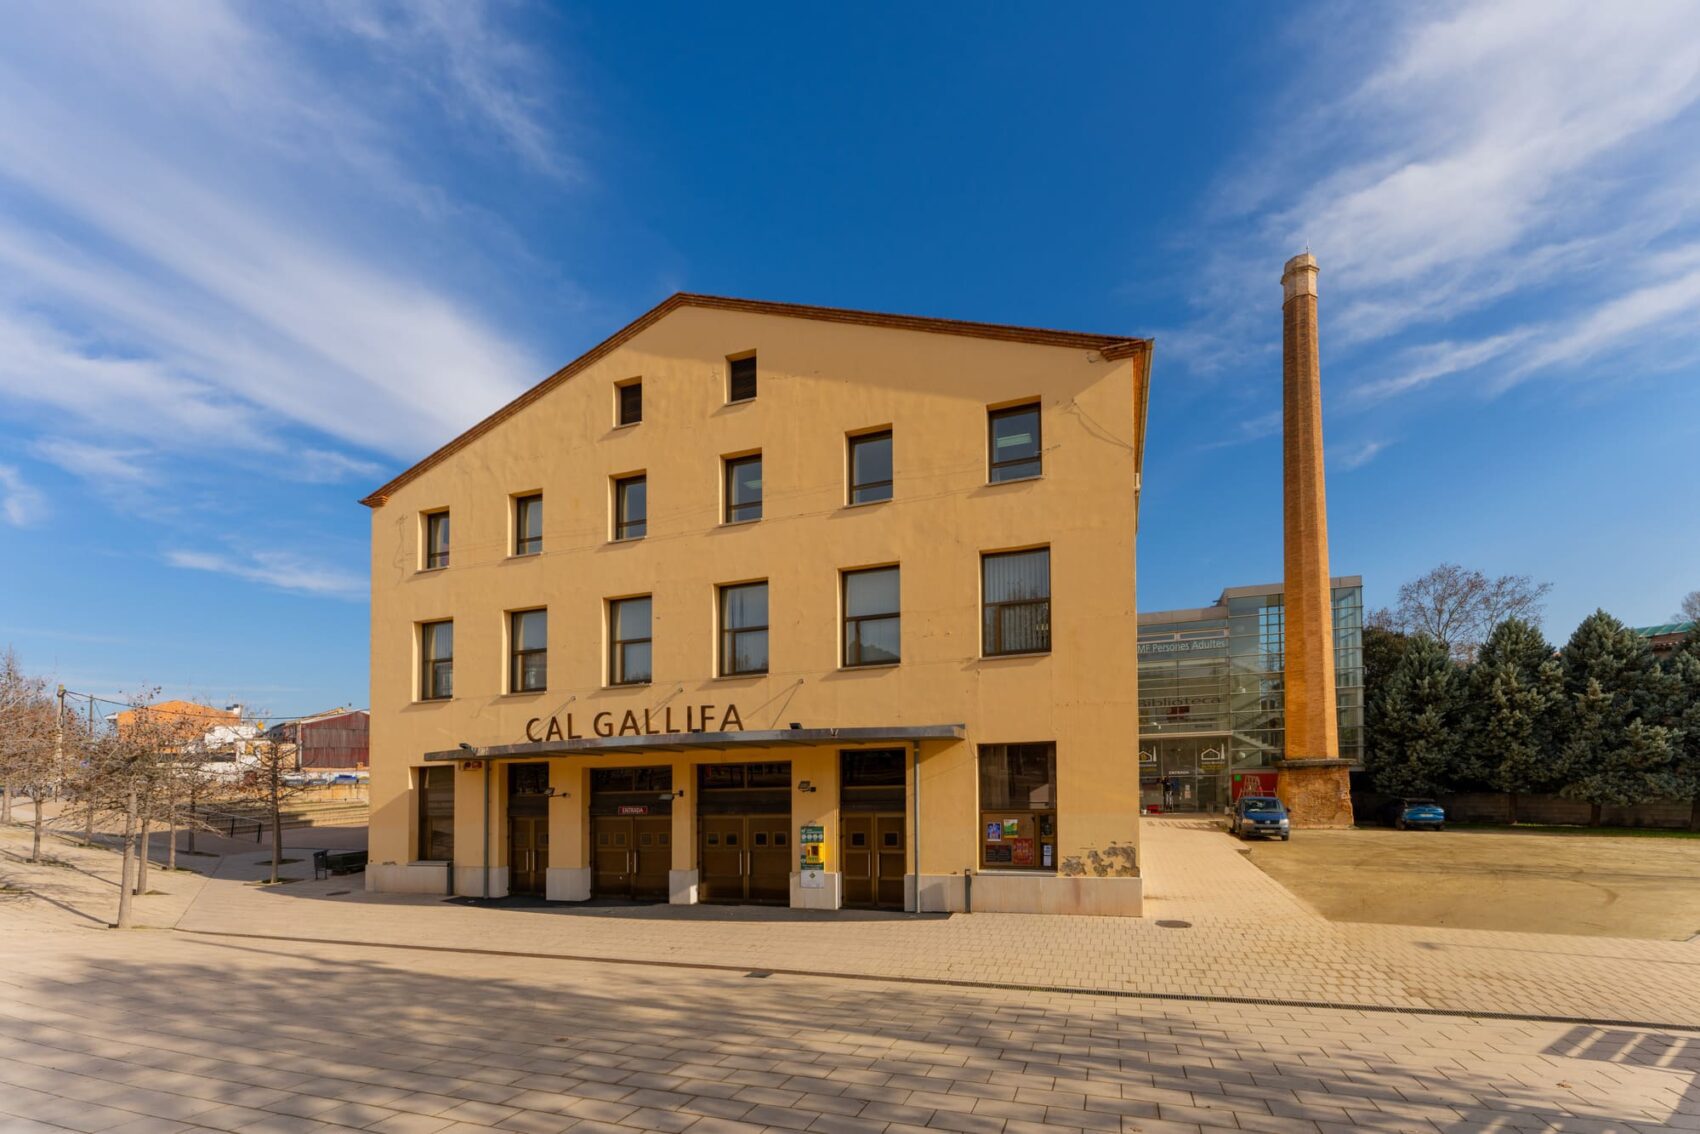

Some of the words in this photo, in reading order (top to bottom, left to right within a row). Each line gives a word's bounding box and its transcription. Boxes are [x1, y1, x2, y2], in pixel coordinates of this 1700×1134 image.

[1152, 642, 1190, 653] Persones
[1192, 640, 1226, 650] Adultes
[1139, 697, 1221, 707] Biblioteca
[526, 713, 583, 743] CAL
[593, 704, 744, 738] GALLIFA
